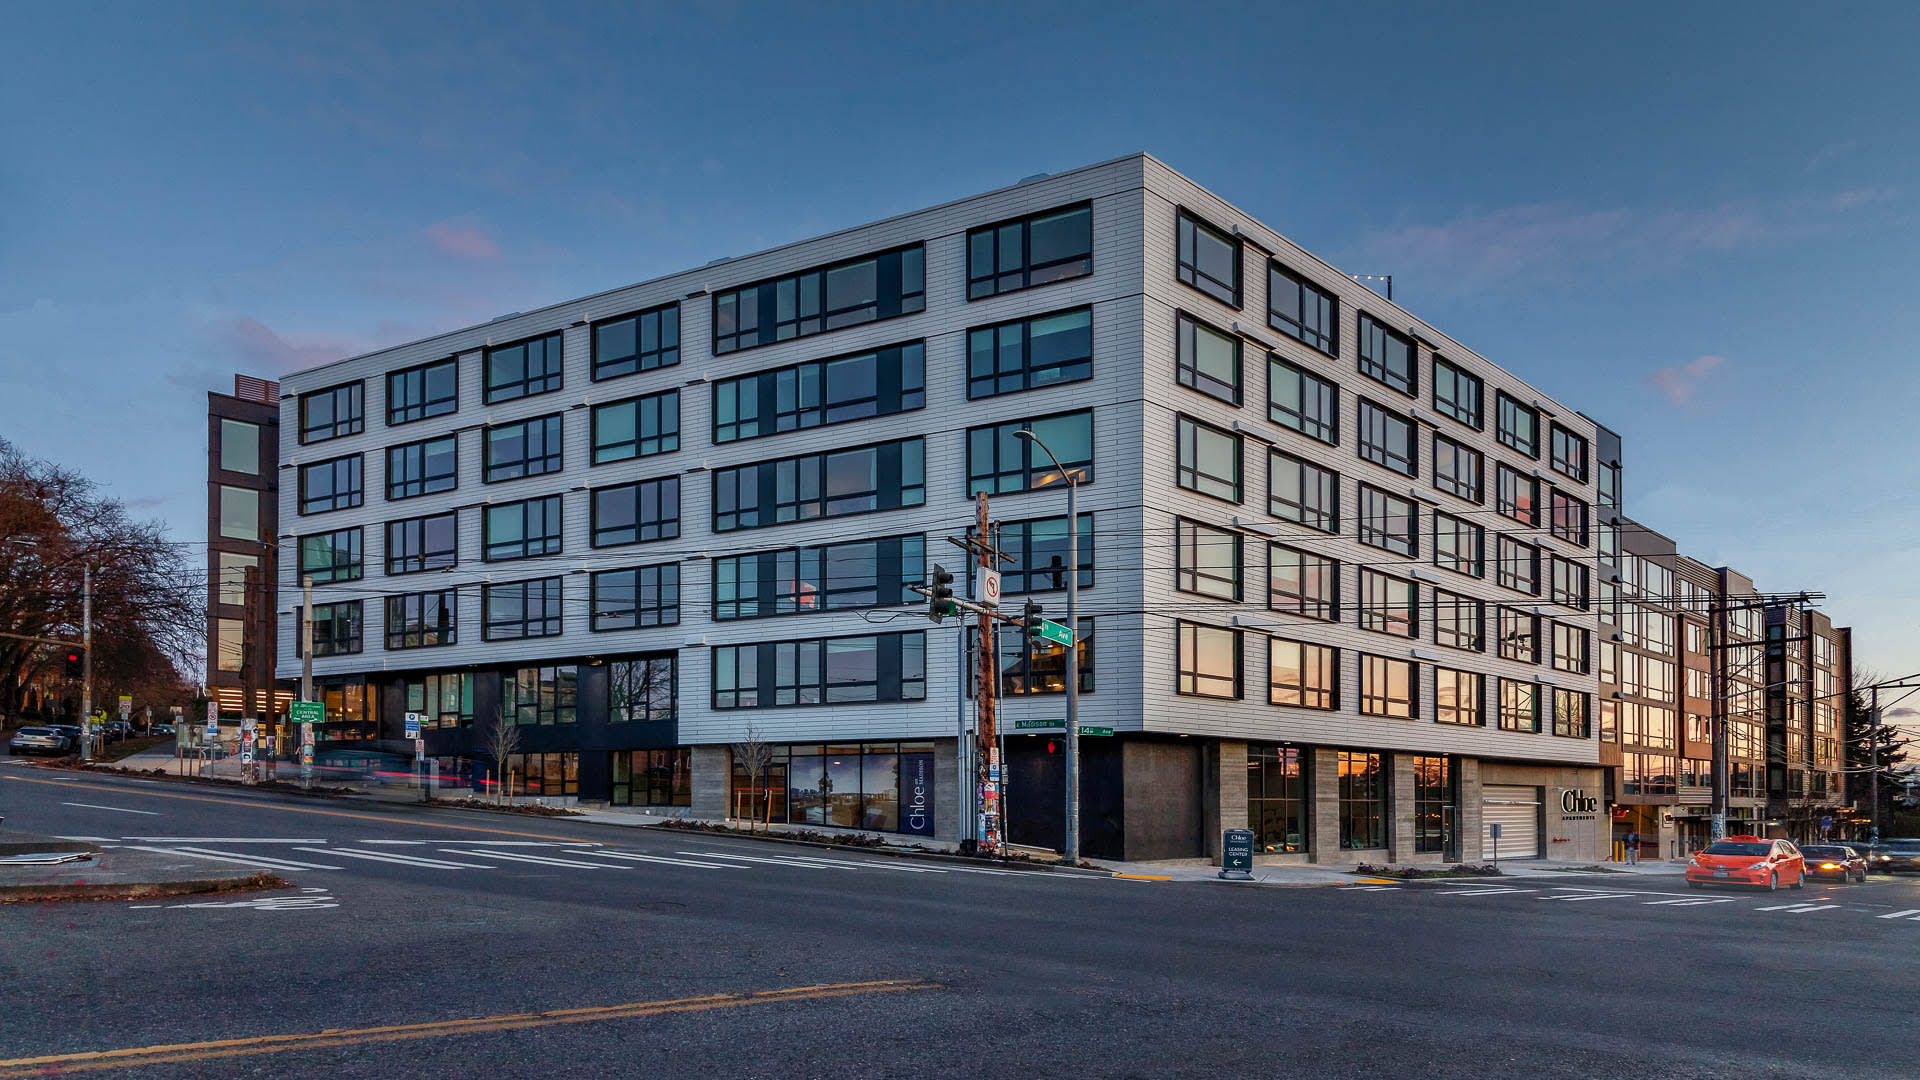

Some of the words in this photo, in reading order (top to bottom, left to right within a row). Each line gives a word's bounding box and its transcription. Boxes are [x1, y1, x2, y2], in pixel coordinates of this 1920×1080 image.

[1058, 629, 1069, 641] Ave
[909, 786, 925, 830] Chloe
[1561, 788, 1598, 814] Chloe
